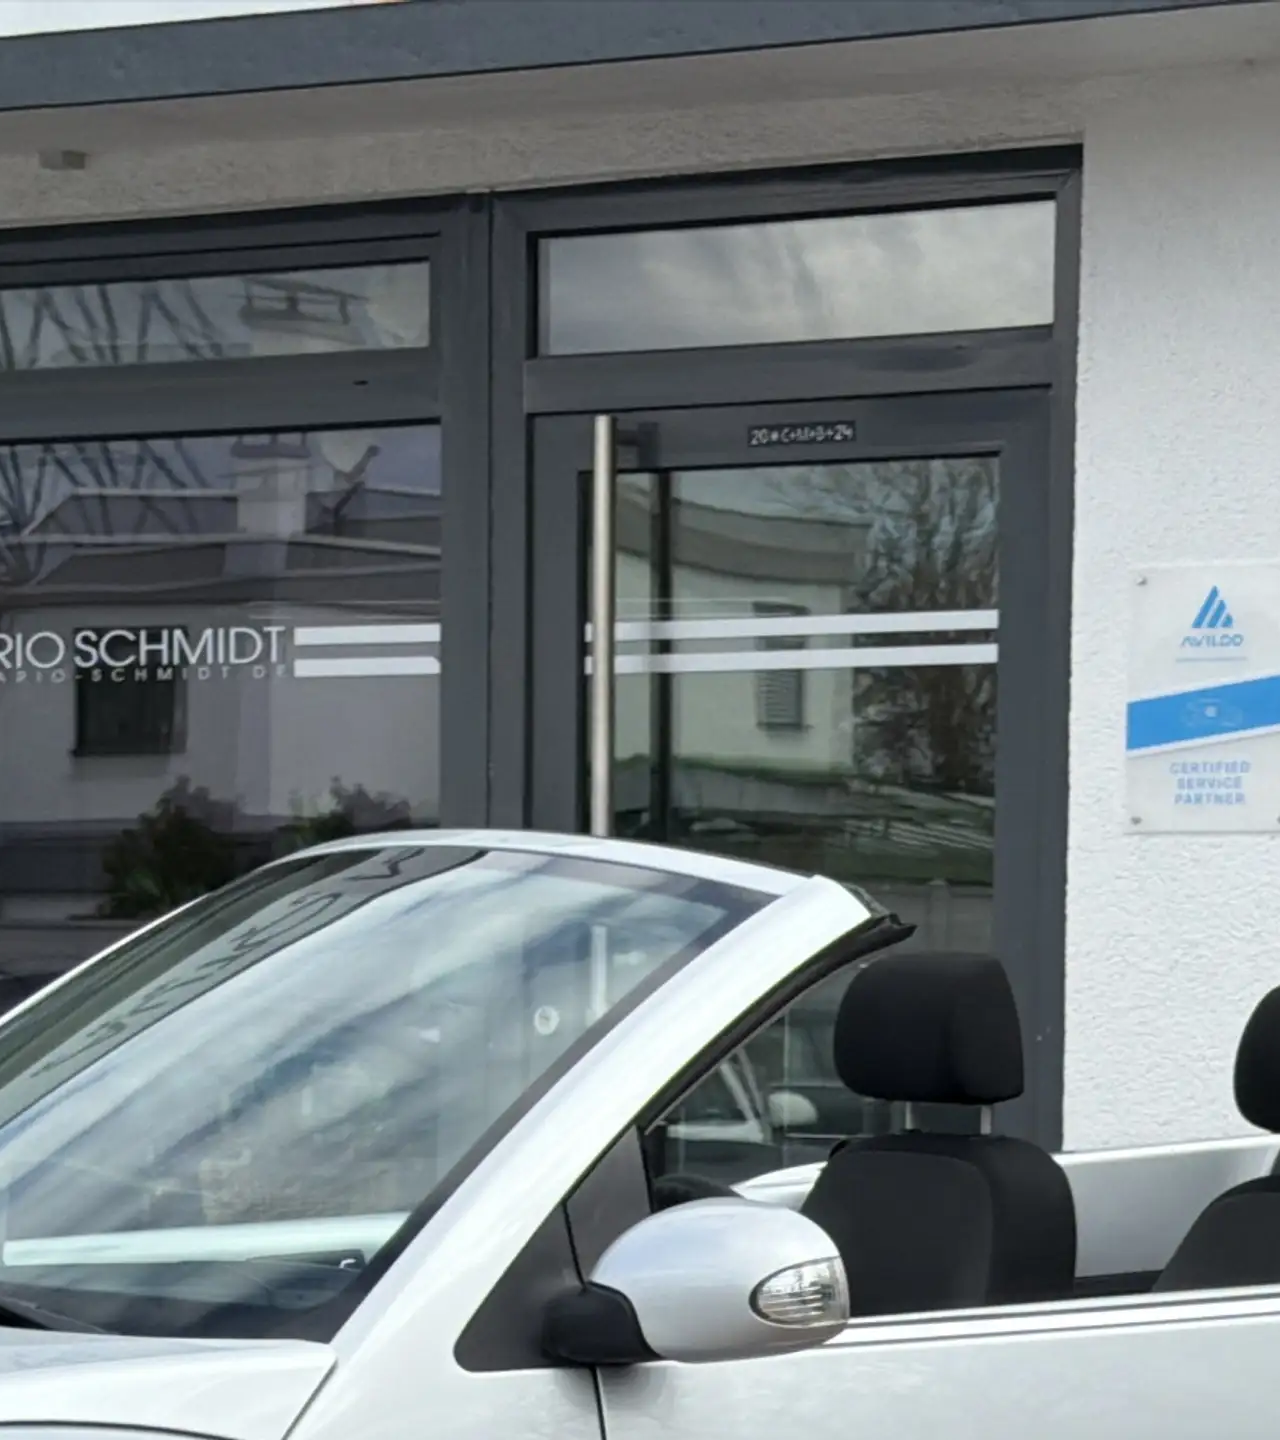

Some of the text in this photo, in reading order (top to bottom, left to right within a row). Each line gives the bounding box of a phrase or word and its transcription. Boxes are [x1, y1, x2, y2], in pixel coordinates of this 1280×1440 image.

[73, 626, 287, 669] SCHMIDT
[1169, 760, 1252, 775] CERTIFIED
[1176, 776, 1243, 790] SERVICE
[1173, 792, 1246, 806] PARTNER
